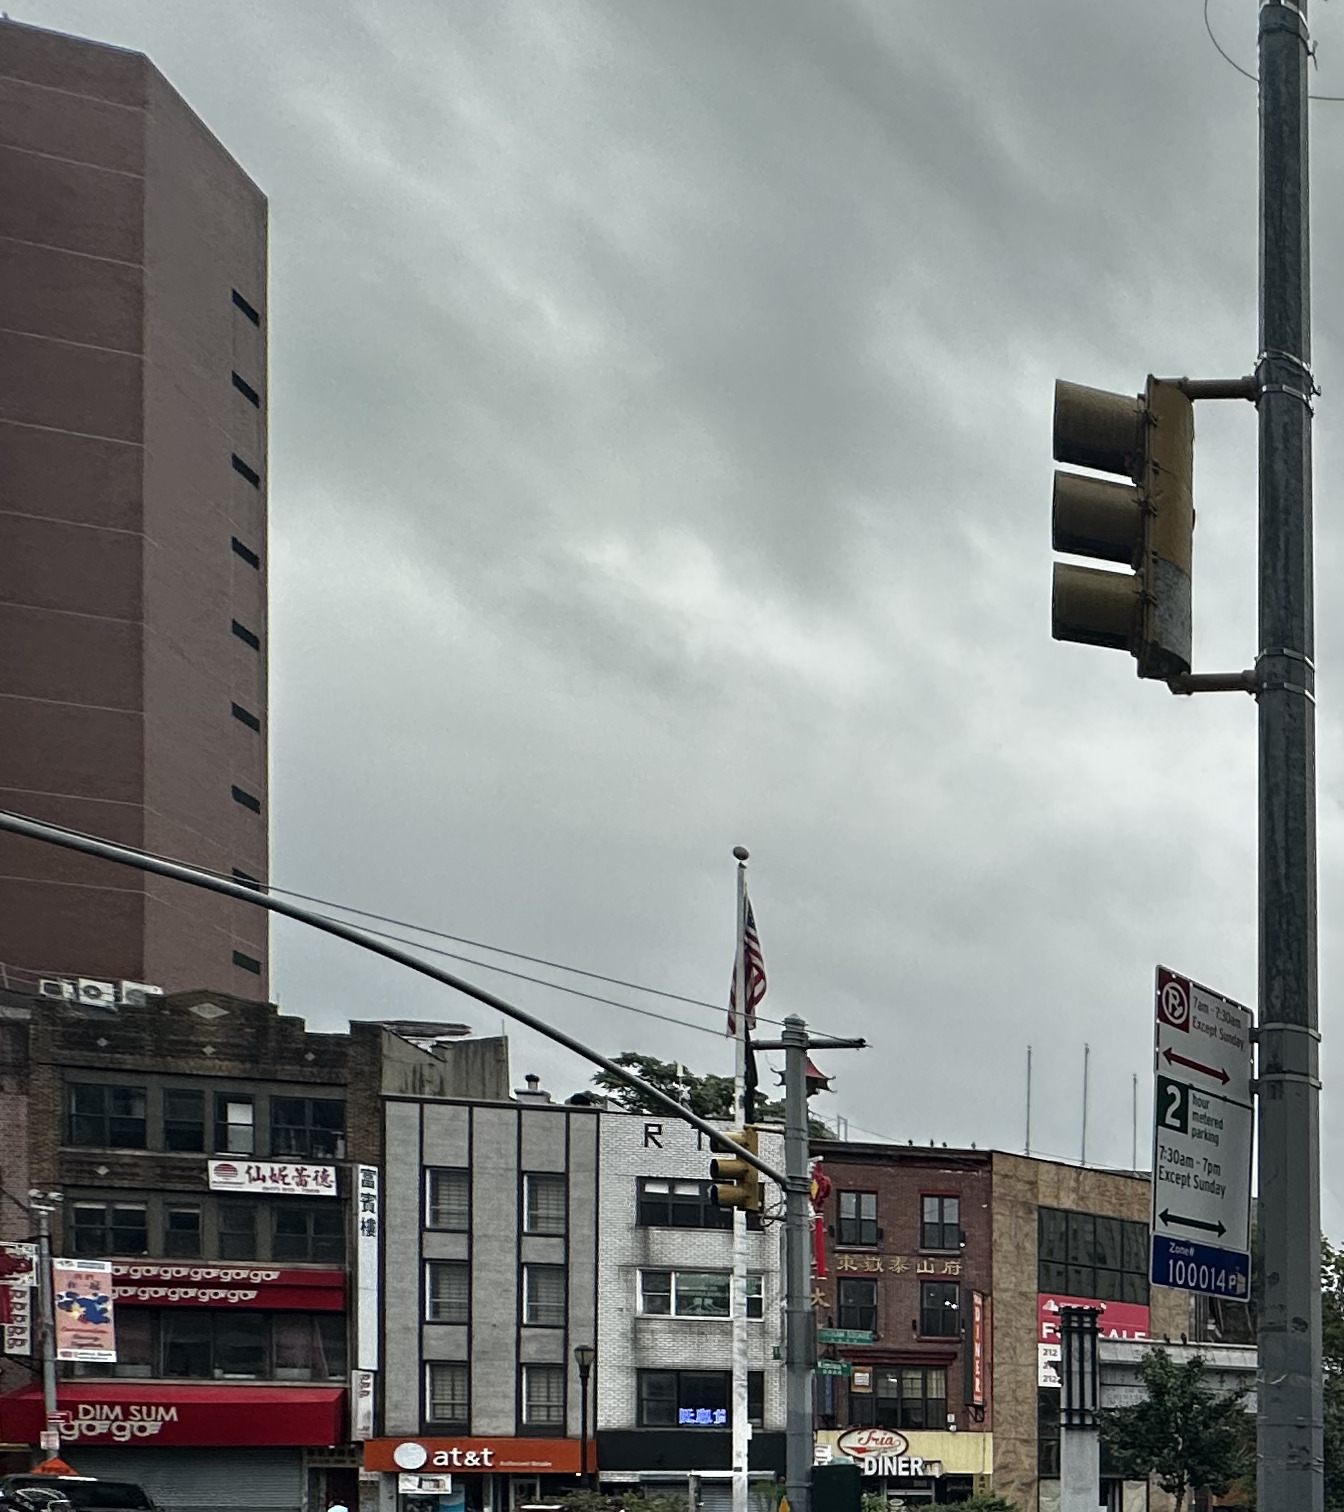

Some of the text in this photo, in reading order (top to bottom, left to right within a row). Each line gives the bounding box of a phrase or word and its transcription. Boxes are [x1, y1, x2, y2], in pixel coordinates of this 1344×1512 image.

[1193, 996, 1209, 1014] 7am
[1192, 1016, 1244, 1051] Except Sunday
[1166, 1084, 1181, 1128] 2
[1192, 1093, 1210, 1110] hour
[1192, 1111, 1223, 1131] metered
[1191, 1126, 1220, 1147] parking
[1159, 1145, 1194, 1169] 7:30am
[1202, 1157, 1221, 1177] 7pm
[1158, 1165, 1227, 1199] Except Sunday
[1168, 1259, 1226, 1292] 100014
[78, 1404, 179, 1421] DIM SUM
[432, 1447, 494, 1467] at&t
[864, 1456, 924, 1476] DINER
